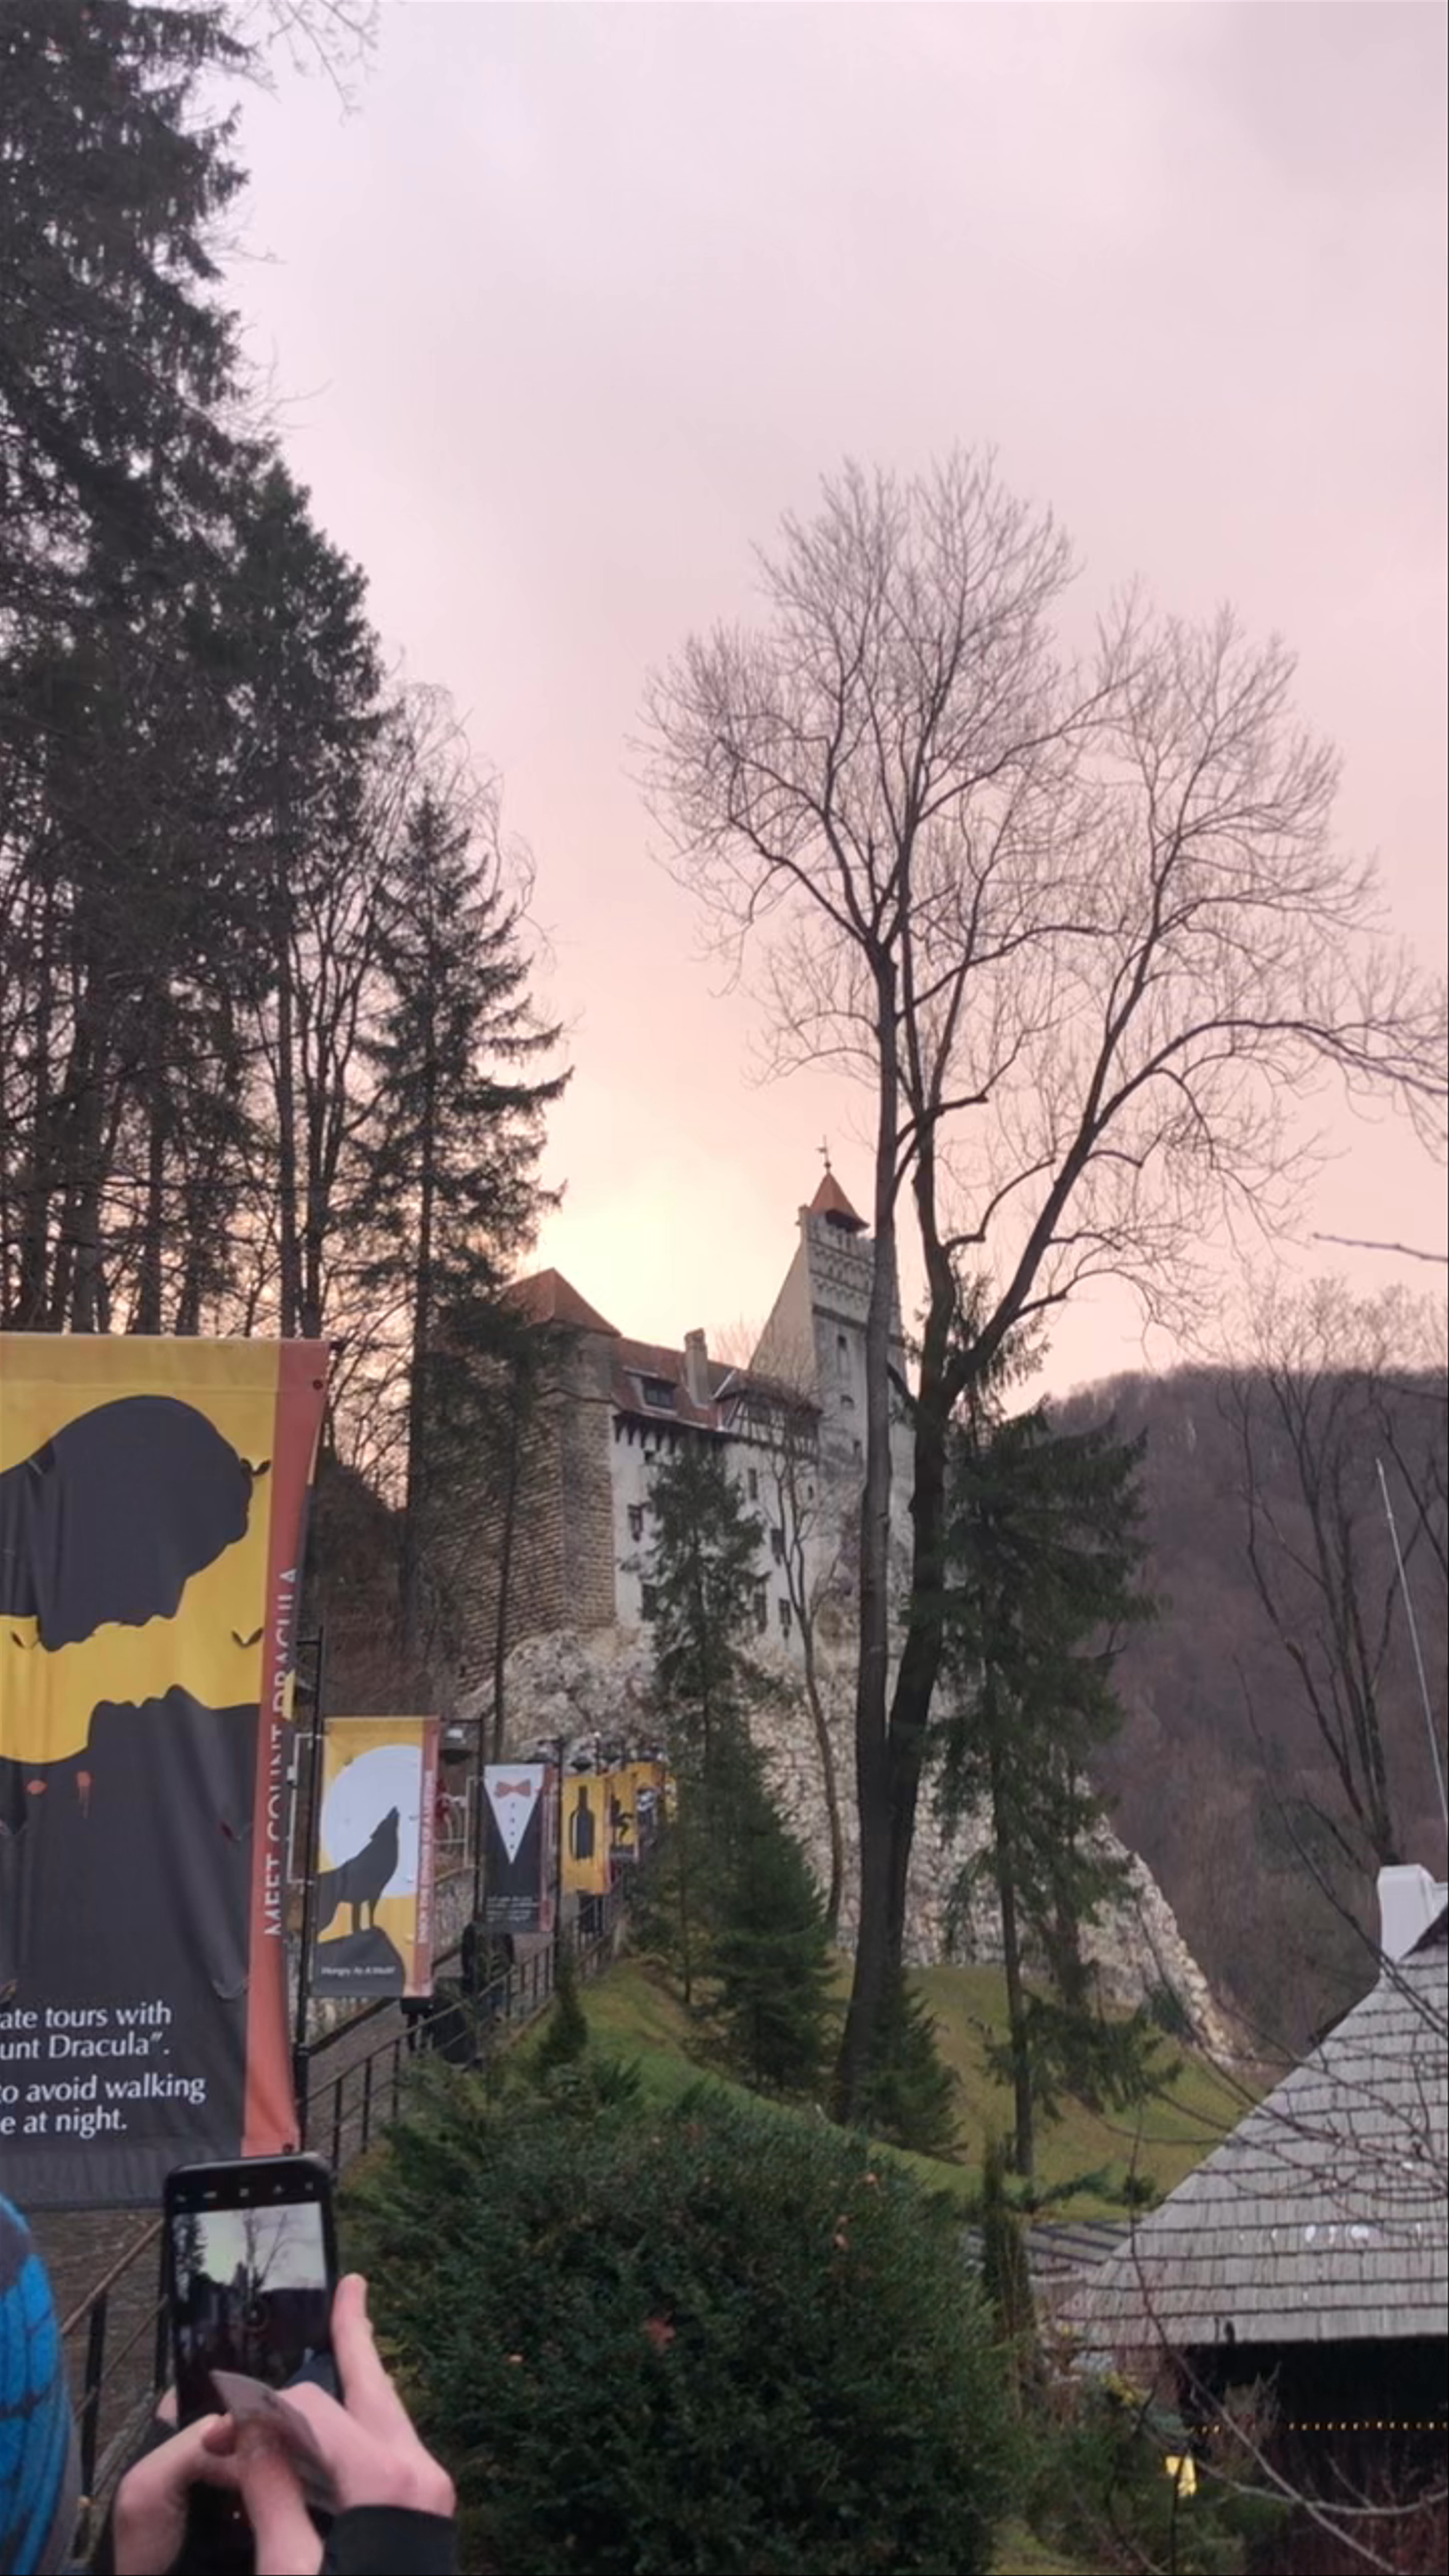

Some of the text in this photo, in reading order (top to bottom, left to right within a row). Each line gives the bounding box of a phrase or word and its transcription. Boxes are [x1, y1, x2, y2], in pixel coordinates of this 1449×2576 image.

[264, 1853, 281, 1935] MEET
[0, 2000, 171, 2030] ate tours with
[0, 2038, 39, 2060] unt
[0, 2072, 206, 2104] o avoid walking
[23, 2111, 47, 2133] at
[55, 2105, 128, 2139] night.
